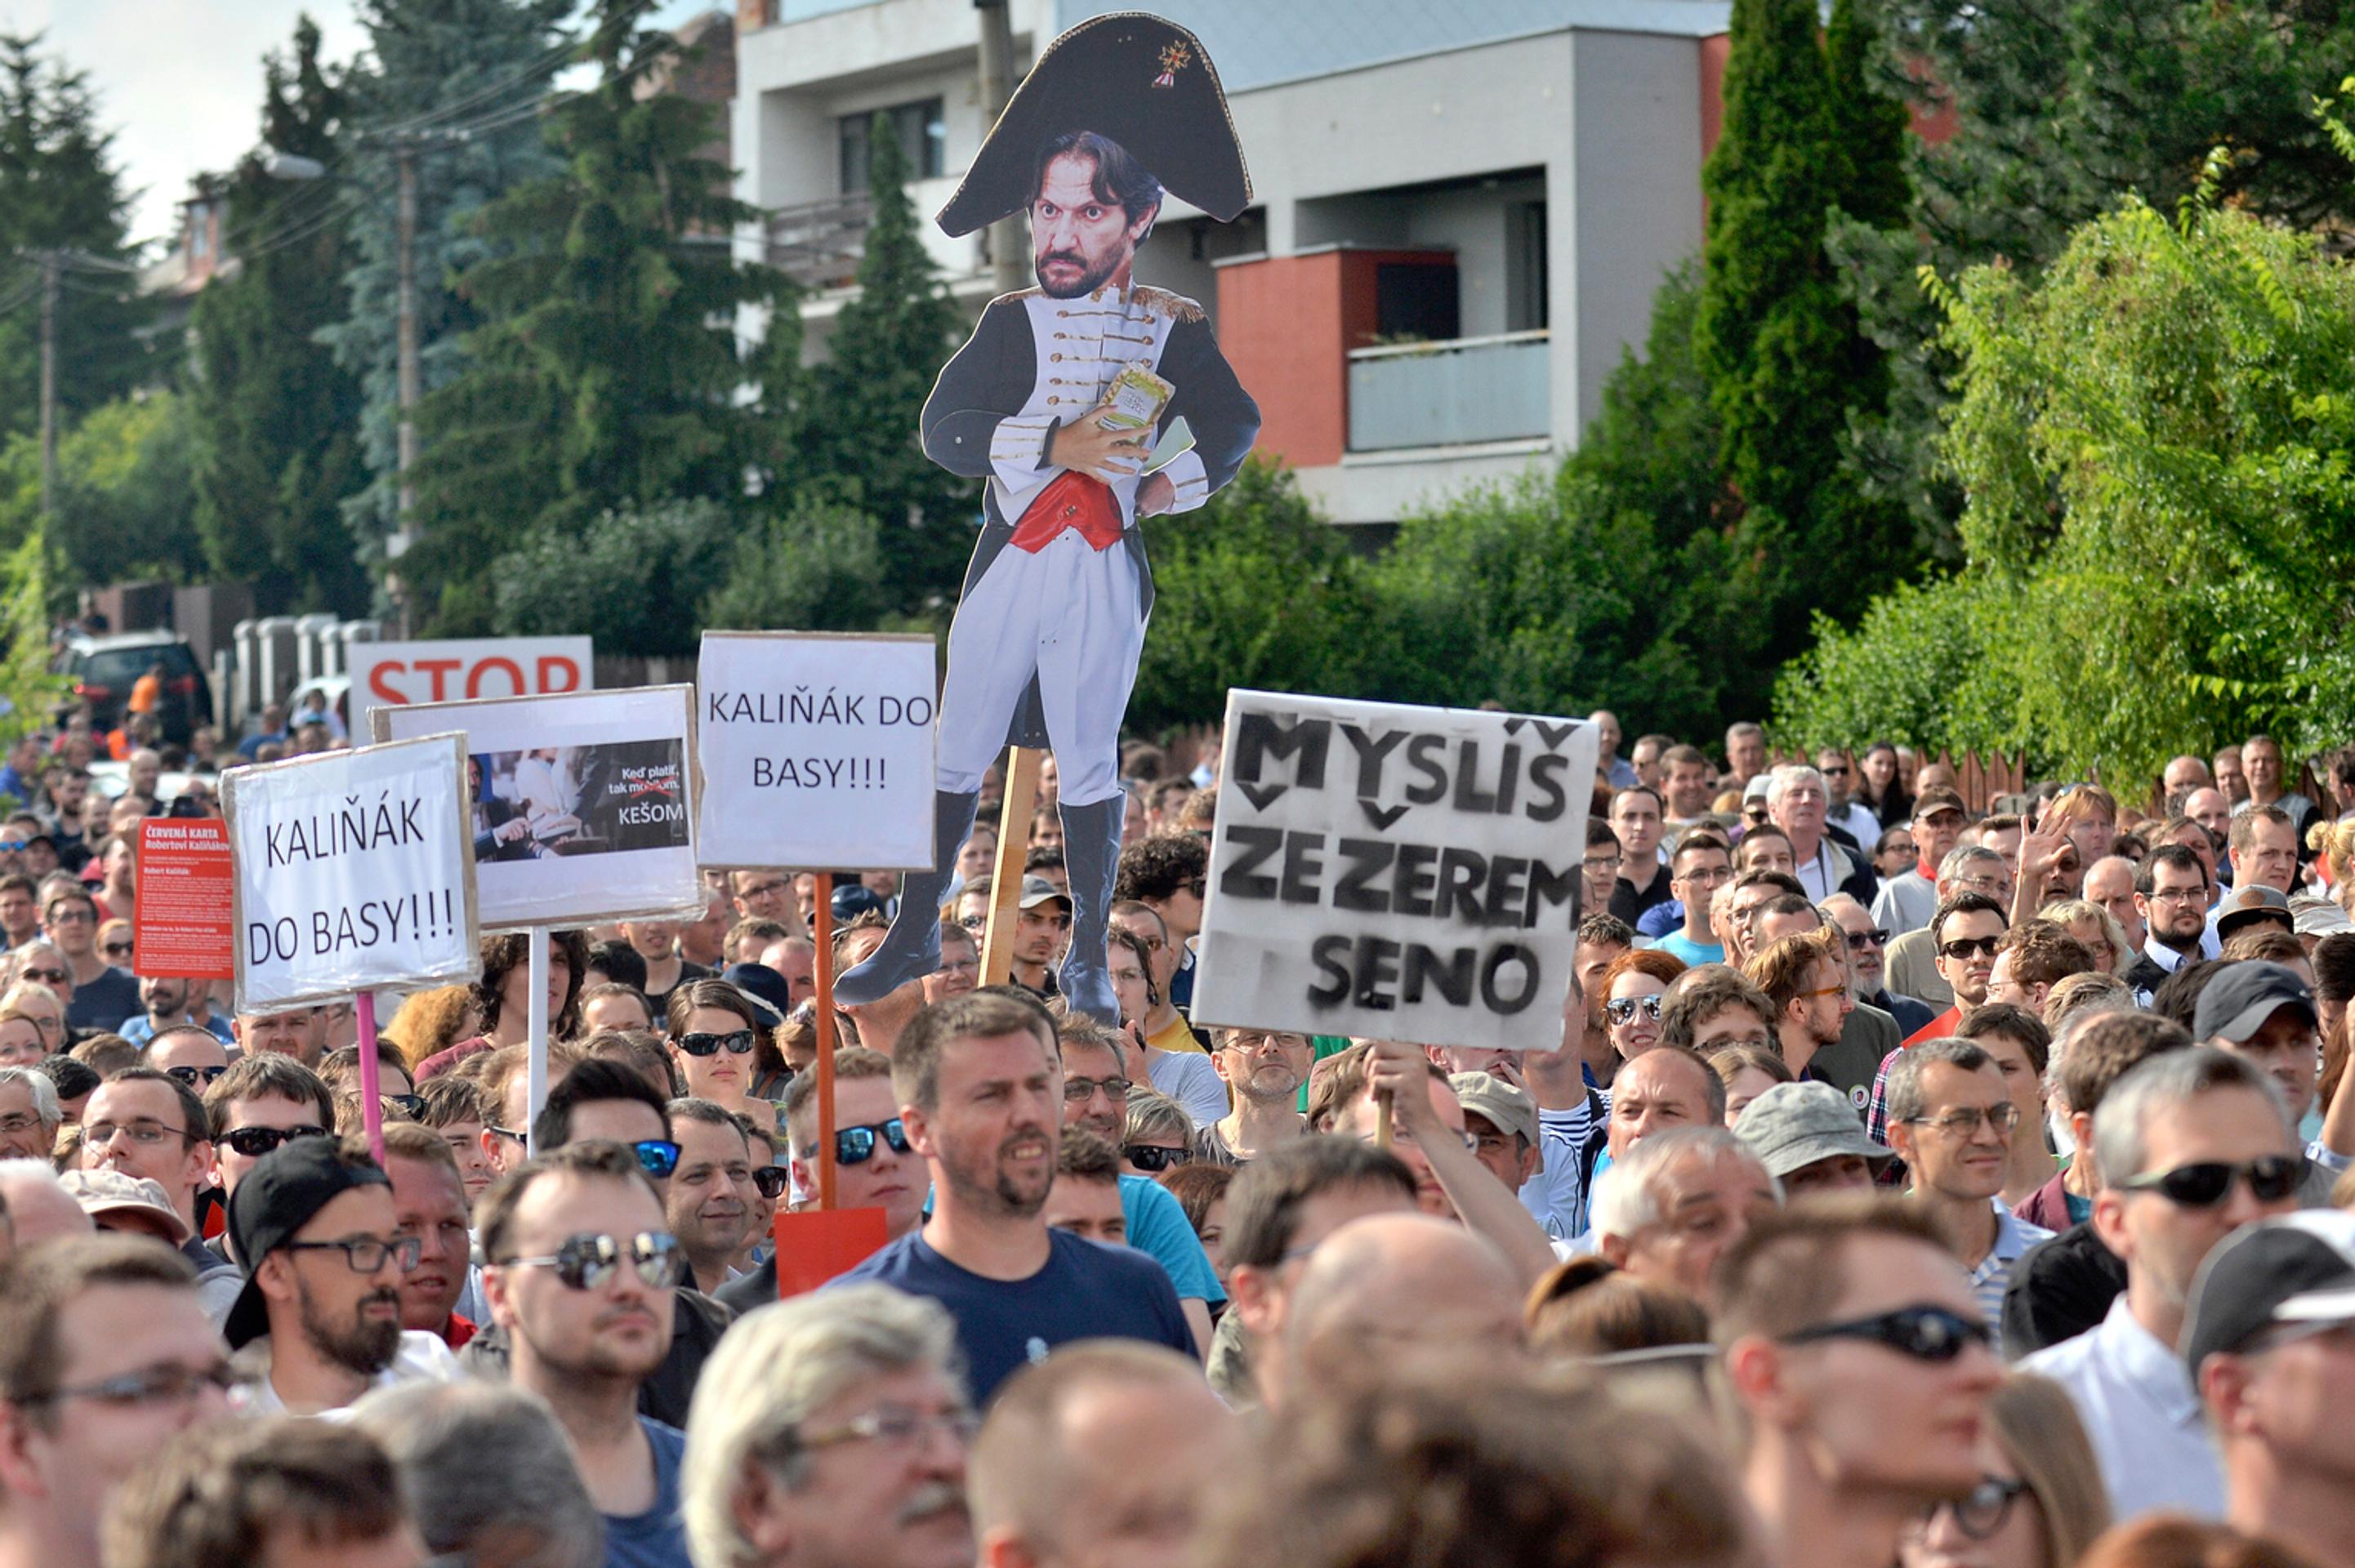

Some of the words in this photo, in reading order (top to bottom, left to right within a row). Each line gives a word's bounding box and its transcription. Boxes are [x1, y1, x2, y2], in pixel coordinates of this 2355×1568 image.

[369, 655, 581, 706] STOP
[709, 684, 865, 725] KALIŇÁK
[879, 696, 932, 727] DO
[609, 782, 627, 795] tak
[753, 757, 885, 790] BASY!!!
[1233, 712, 1581, 822] MYSLÍŠ
[189, 828, 218, 840] KARTA
[266, 789, 424, 868] KALIŇÁK
[618, 801, 685, 826] KEŠOM
[248, 916, 298, 966] DO
[312, 889, 453, 956] BASY!!!
[1307, 933, 1541, 1016] SENO
